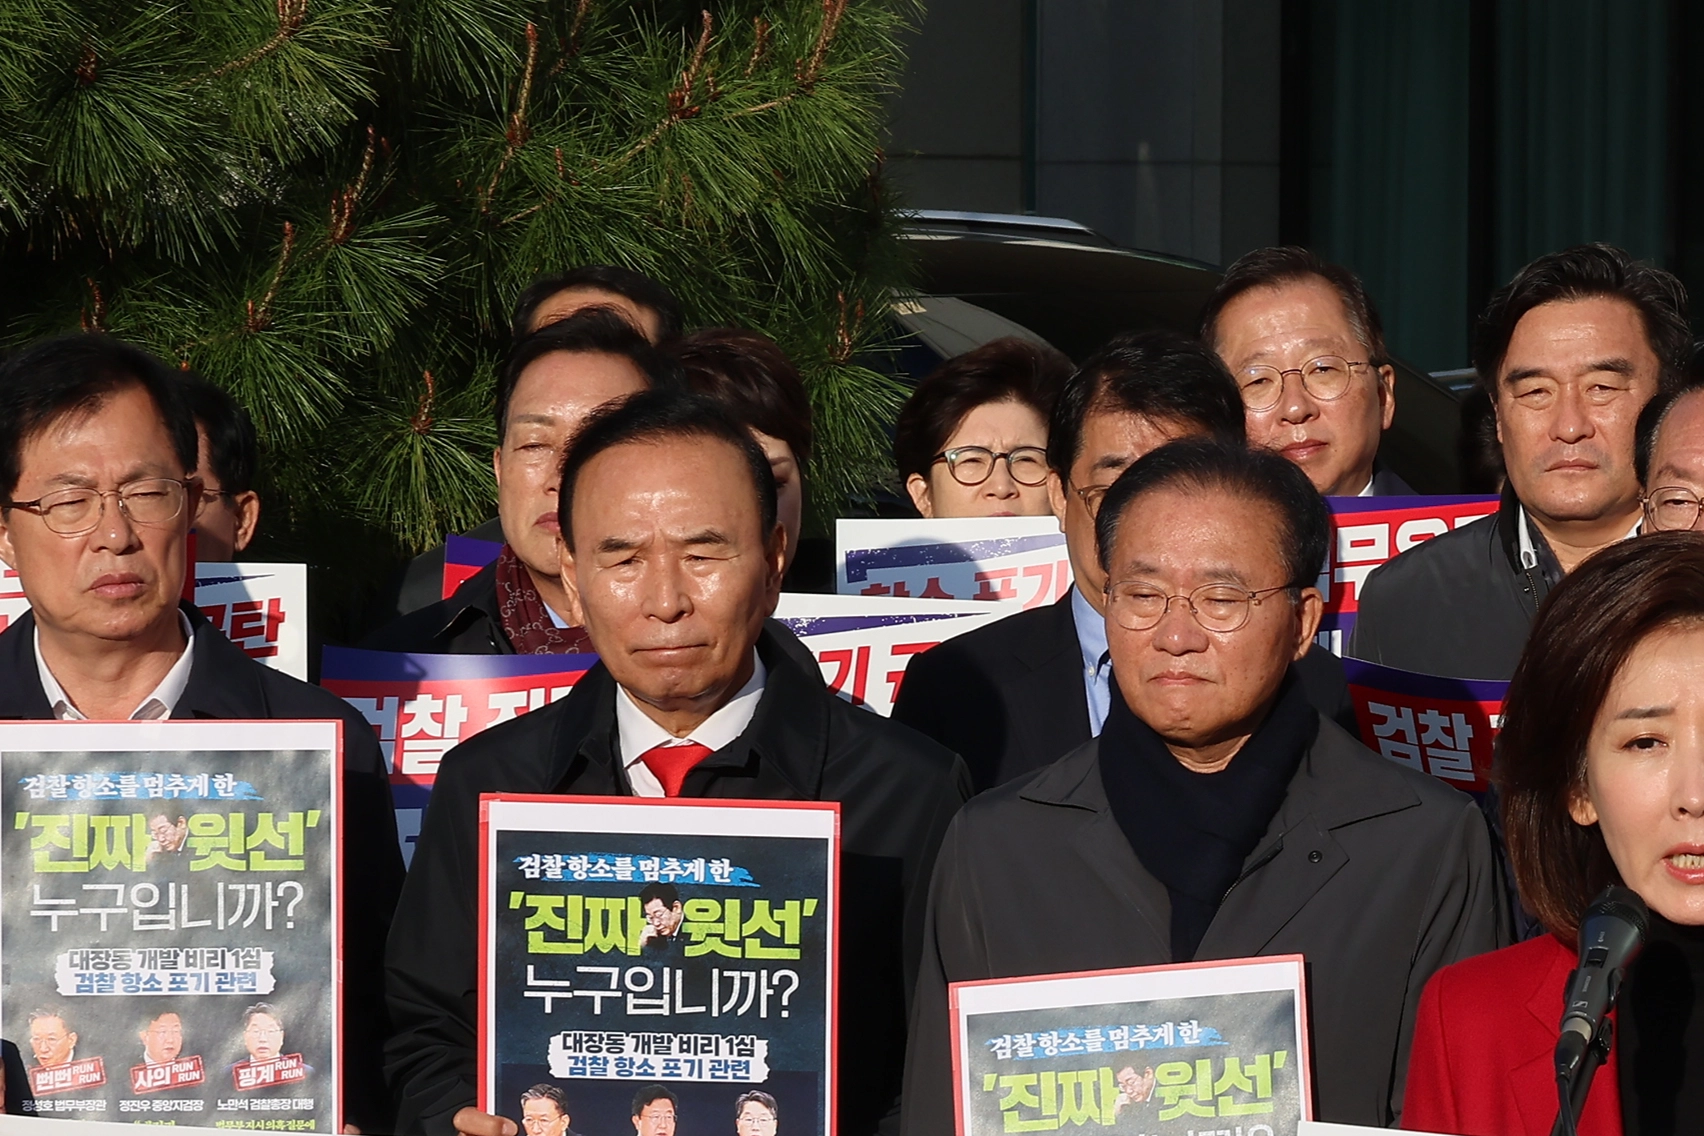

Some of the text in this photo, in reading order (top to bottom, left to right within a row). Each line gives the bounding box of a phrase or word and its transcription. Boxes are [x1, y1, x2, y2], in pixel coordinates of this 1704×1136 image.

[1367, 701, 1476, 782] 검찰
[23, 773, 238, 798] 검찰 항소를 멈추게 한
[14, 810, 150, 872] '진짜
[186, 809, 321, 871] 윗선'
[518, 853, 734, 883] 검찰 항소를 멈추게 한
[30, 881, 303, 931] 누구입니까?
[509, 891, 818, 960] '진짜 윗선'
[69, 947, 261, 970] 대장동 개발 비리 1심
[74, 971, 256, 993] 검찰 항소 포기 관련
[523, 963, 799, 1018] 누구입니까?
[562, 1031, 755, 1057] 대장동 개발 비리 1심
[990, 1019, 1204, 1060] 검찰 항소를 멈추게 한
[567, 1055, 750, 1080] 검찰 항소 포기 관련
[982, 1050, 1291, 1135] '진짜 윗선'
